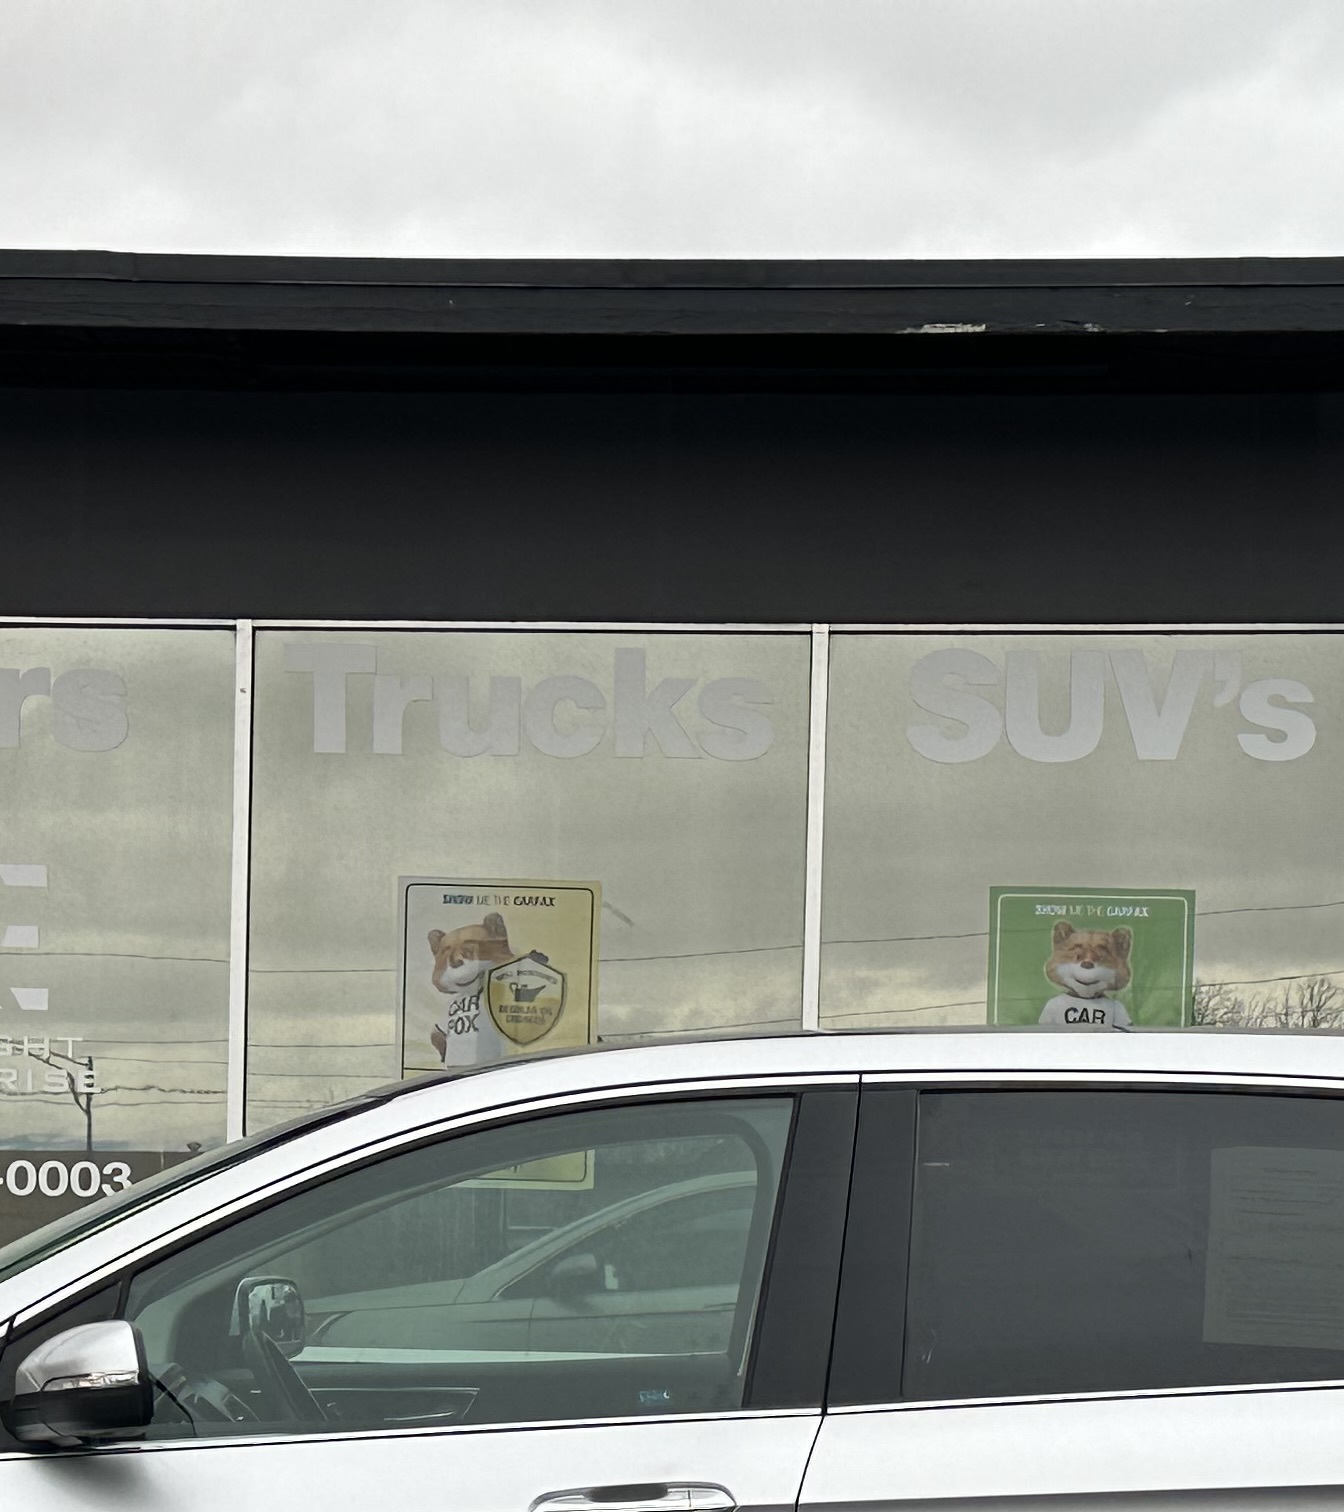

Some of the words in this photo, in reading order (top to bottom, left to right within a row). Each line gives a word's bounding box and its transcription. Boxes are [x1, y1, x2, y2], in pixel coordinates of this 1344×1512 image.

[284, 643, 774, 762] Trucks
[906, 648, 1316, 764] SUV's
[1064, 1006, 1106, 1024] CAR
